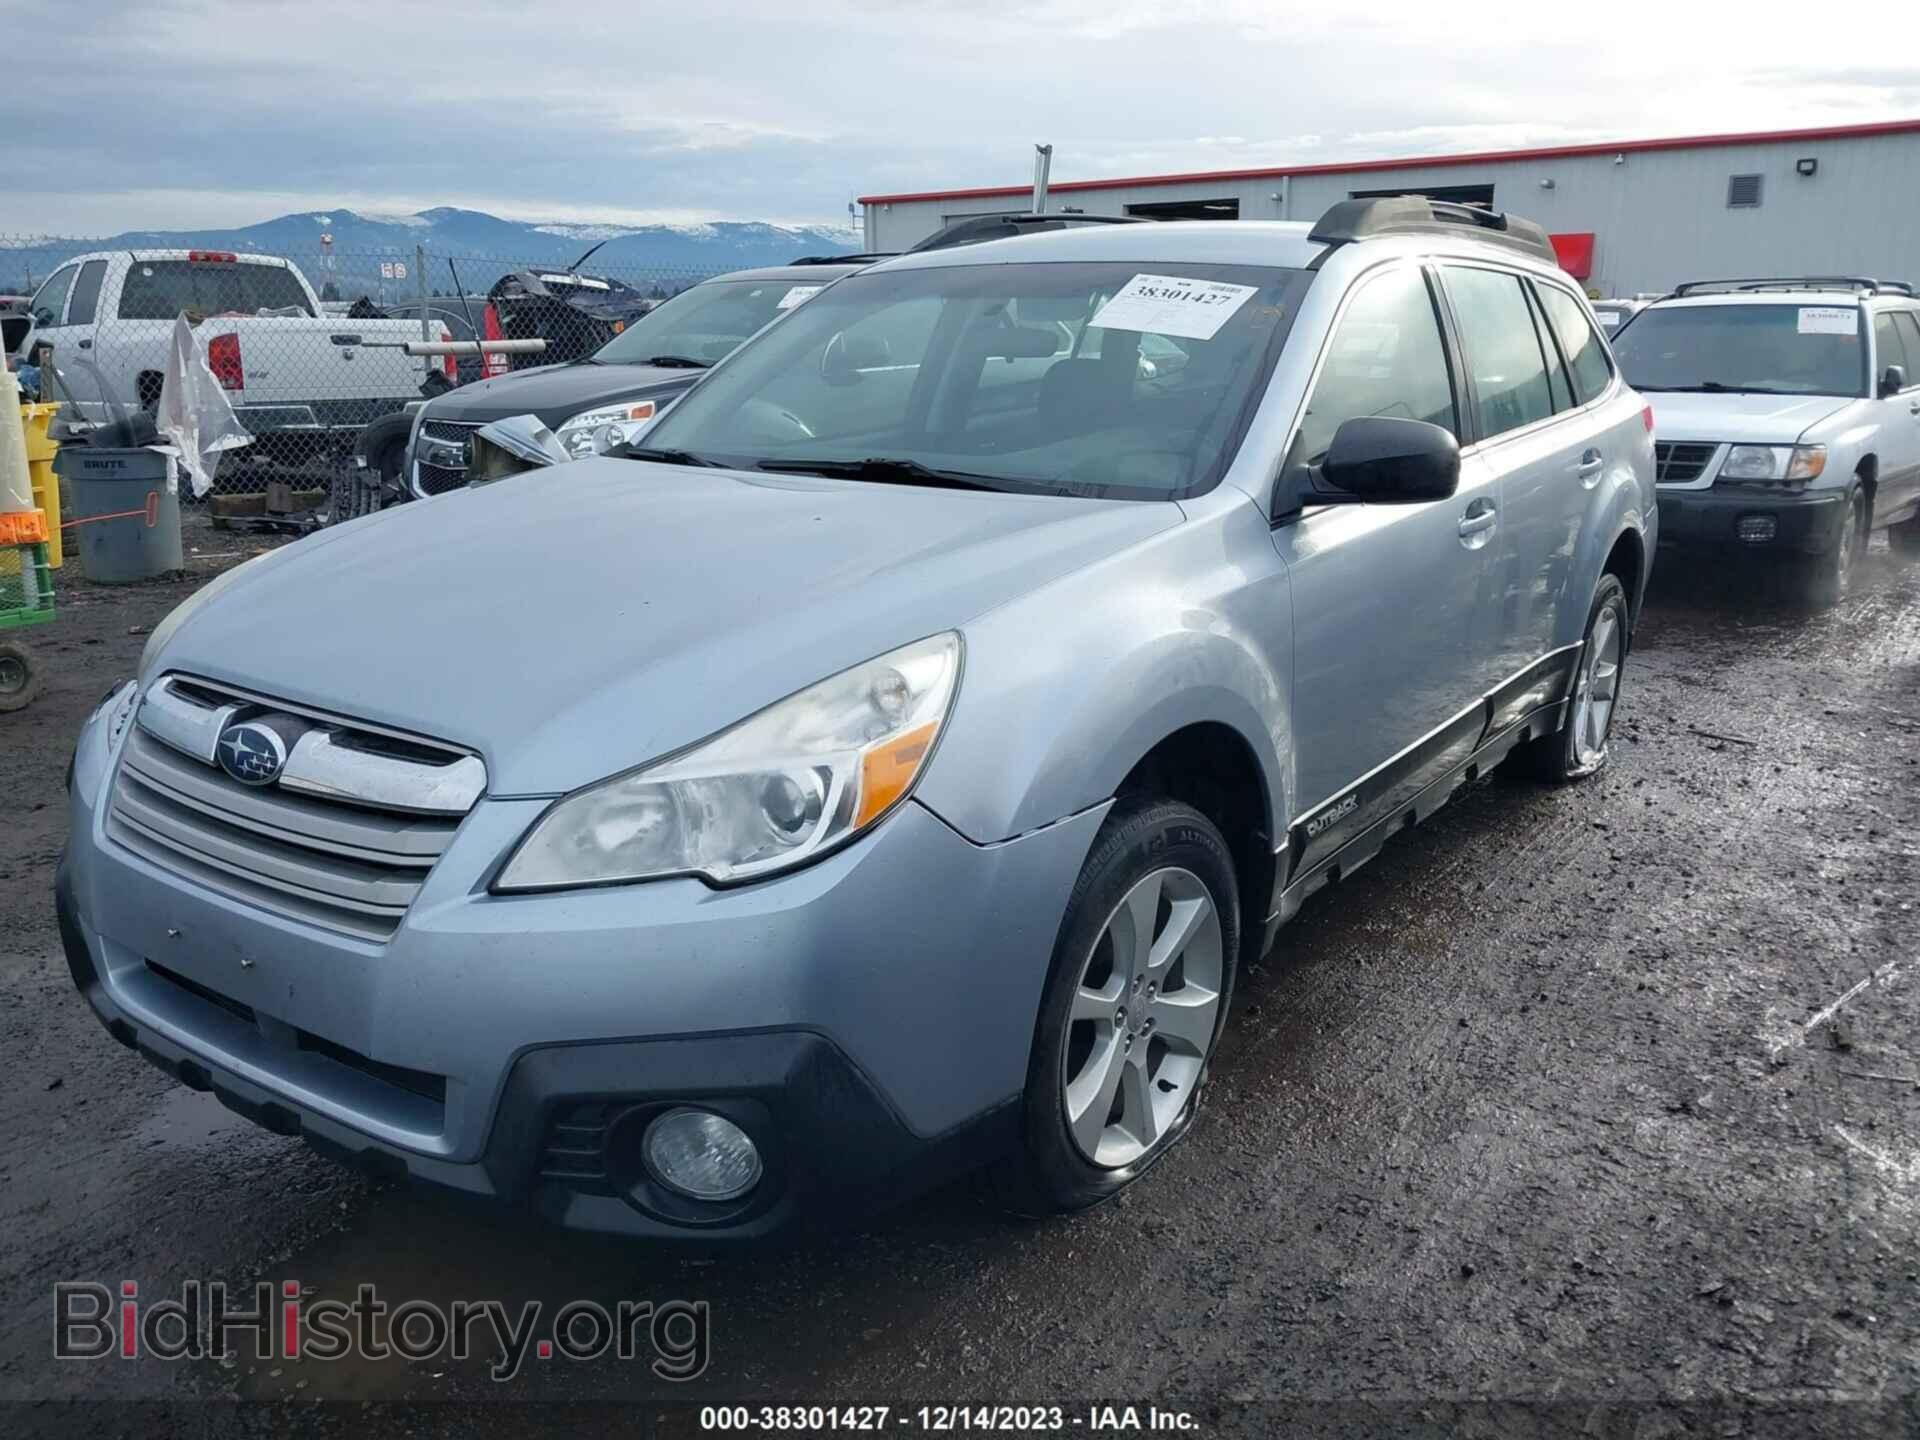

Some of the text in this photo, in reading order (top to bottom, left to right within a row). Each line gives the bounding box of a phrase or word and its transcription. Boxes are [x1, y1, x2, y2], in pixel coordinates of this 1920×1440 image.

[1133, 285, 1232, 305] 38301427
[84, 460, 128, 469] BRUTE
[1307, 794, 1359, 837] OUTBACK
